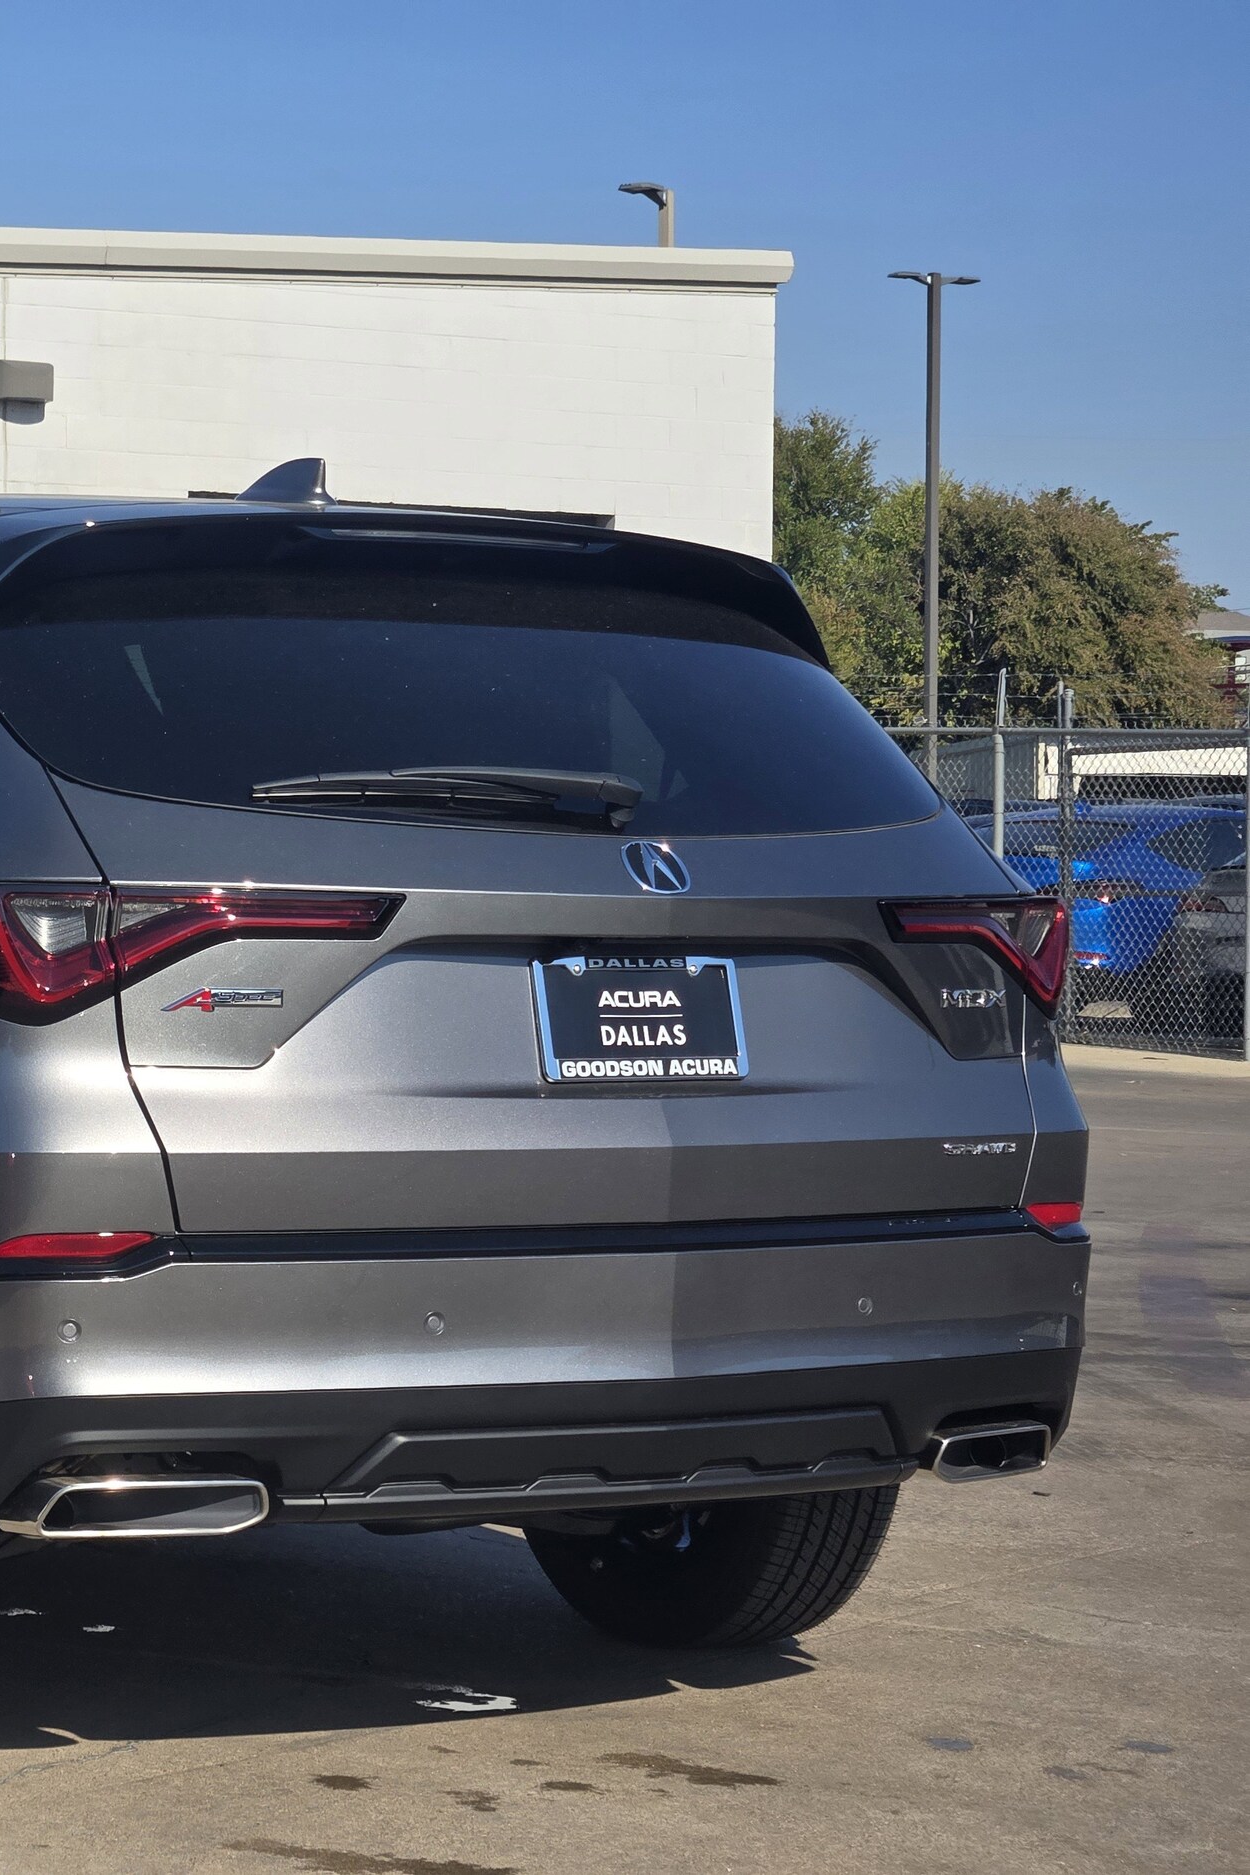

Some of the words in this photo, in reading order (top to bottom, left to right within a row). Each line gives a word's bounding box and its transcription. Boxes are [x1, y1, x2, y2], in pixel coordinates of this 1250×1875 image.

[588, 958, 685, 968] DALLAS
[598, 990, 682, 1008] ACURA
[940, 988, 1006, 1008] MDX
[600, 1024, 687, 1046] DALLAS
[561, 1059, 664, 1077] GOODSON
[669, 1058, 738, 1076] ACURA
